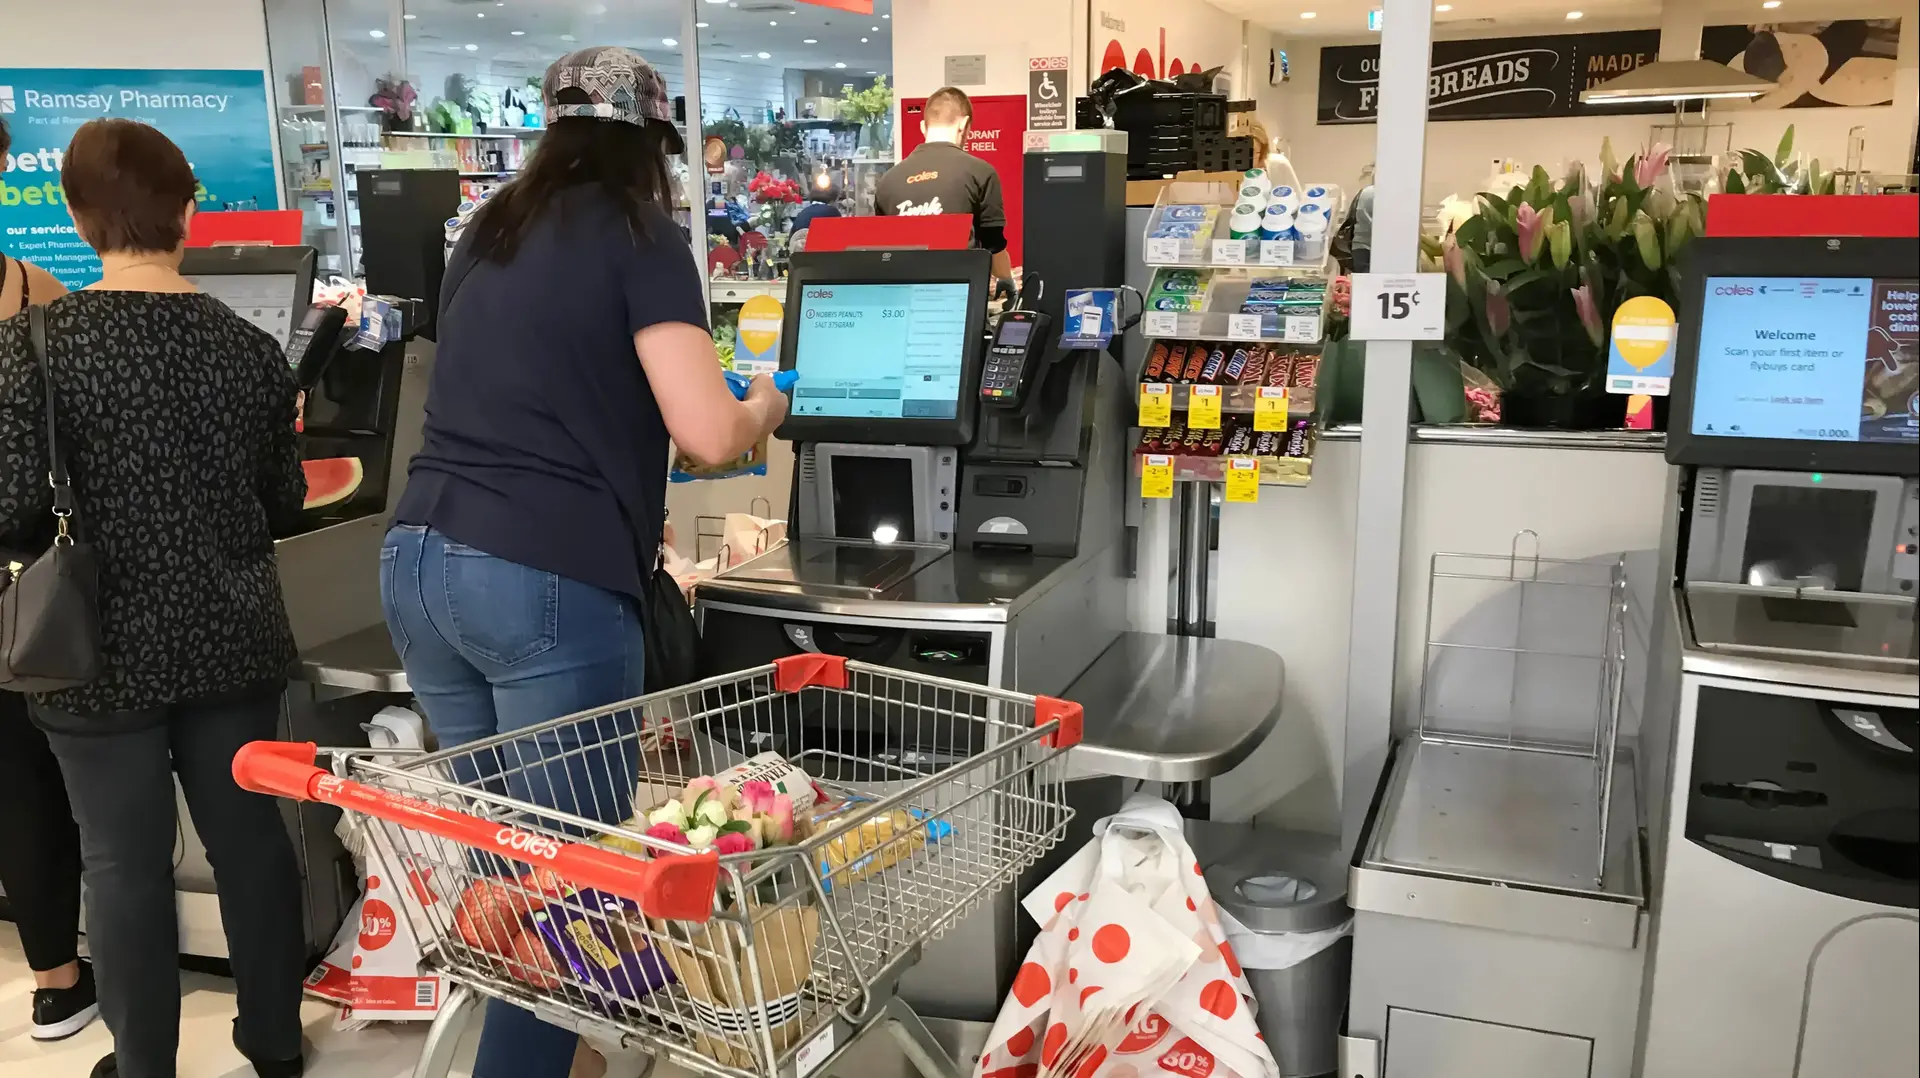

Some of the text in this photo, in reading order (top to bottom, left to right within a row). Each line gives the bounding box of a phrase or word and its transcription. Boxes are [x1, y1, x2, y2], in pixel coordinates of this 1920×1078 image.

[1030, 57, 1067, 69] coles
[1360, 59, 1380, 73] OU
[24, 89, 228, 112] Ramsay Pharmacy
[971, 143, 997, 151] REEL
[906, 171, 939, 184] coles
[6, 227, 28, 235] our
[19, 240, 91, 250] Expert Pharmacis
[807, 289, 833, 299] coles
[1715, 285, 1754, 296] coles
[1887, 290, 1919, 302] Help
[1882, 300, 1918, 311] lower
[882, 310, 905, 318] $3.00
[1889, 312, 1918, 321] cost
[1889, 322, 1919, 332] dinn
[1755, 330, 1816, 341] Welcome
[1725, 347, 1749, 357] Scan
[1752, 349, 1777, 358] your
[1779, 348, 1799, 358] first
[1801, 349, 1829, 358] item
[1750, 361, 1815, 371] flybuys card
[496, 827, 564, 860] coles
